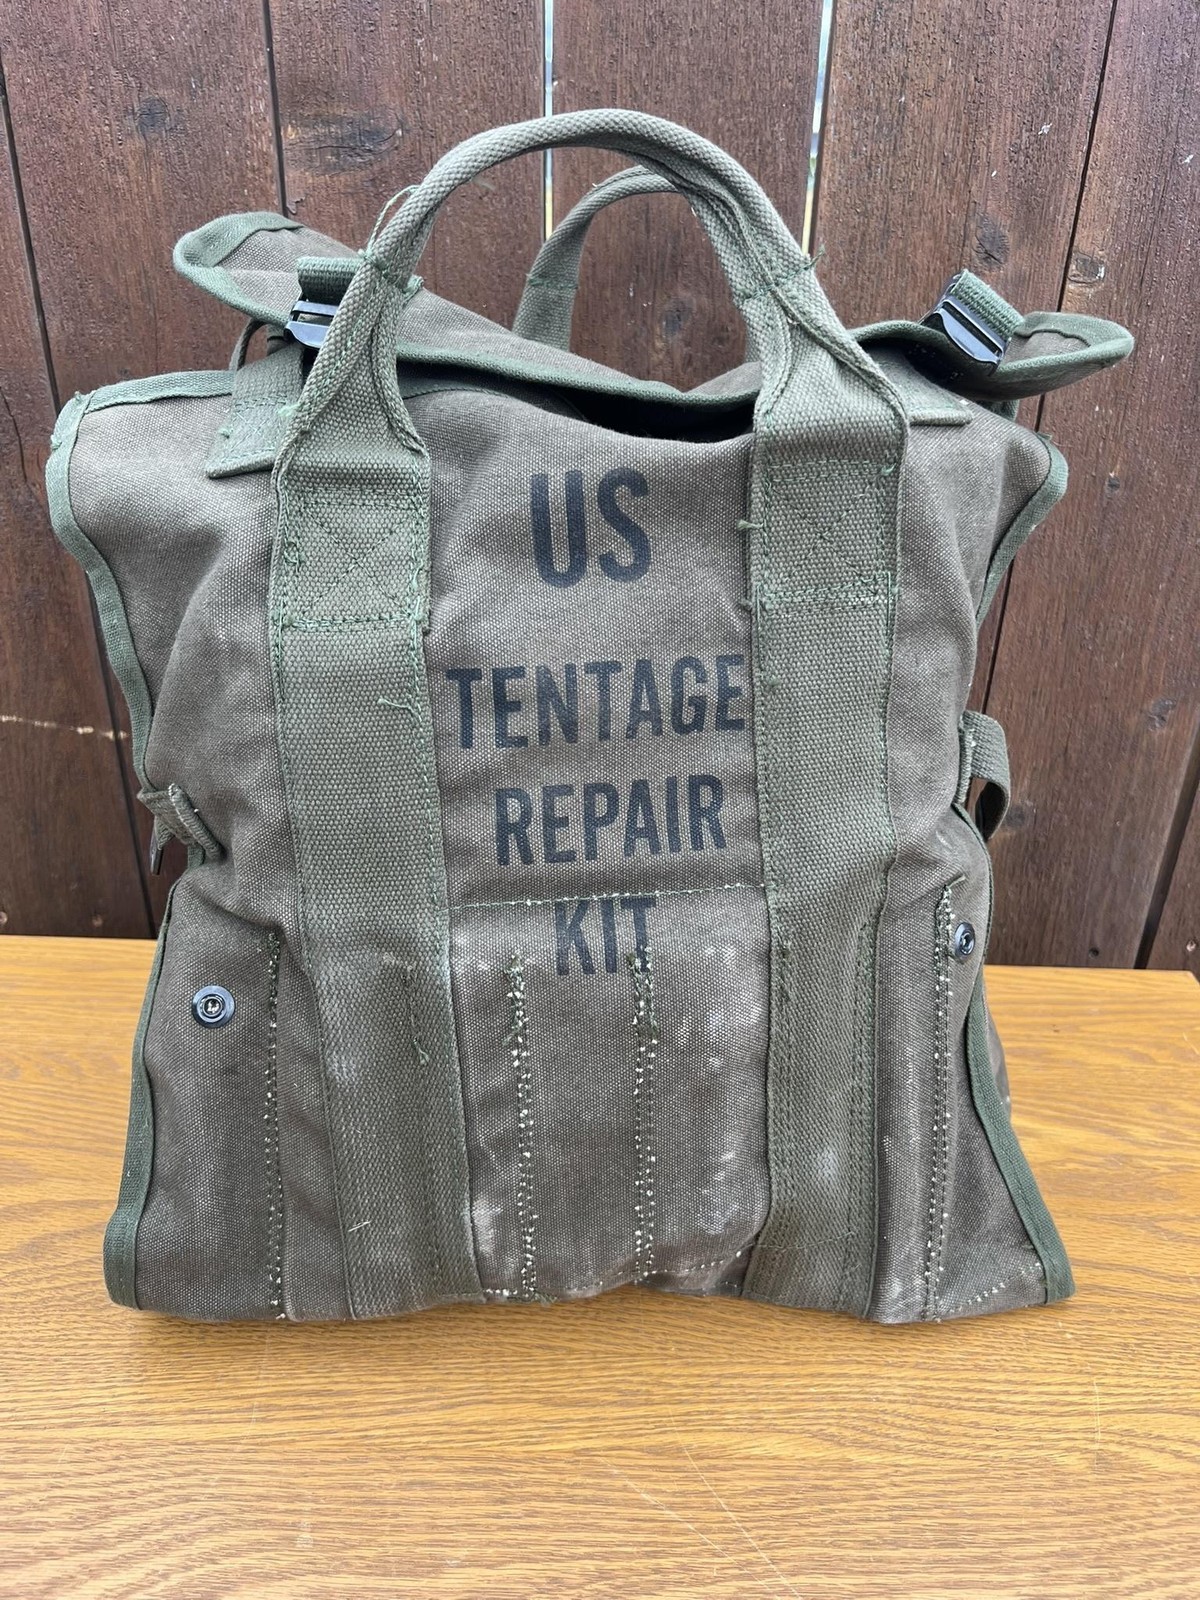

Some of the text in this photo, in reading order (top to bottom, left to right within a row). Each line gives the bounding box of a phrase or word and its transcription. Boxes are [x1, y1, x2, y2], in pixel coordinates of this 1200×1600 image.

[529, 467, 652, 589] US
[445, 653, 746, 749] TENTAGE
[494, 774, 727, 866] REPAIR
[553, 897, 656, 976] KIT
